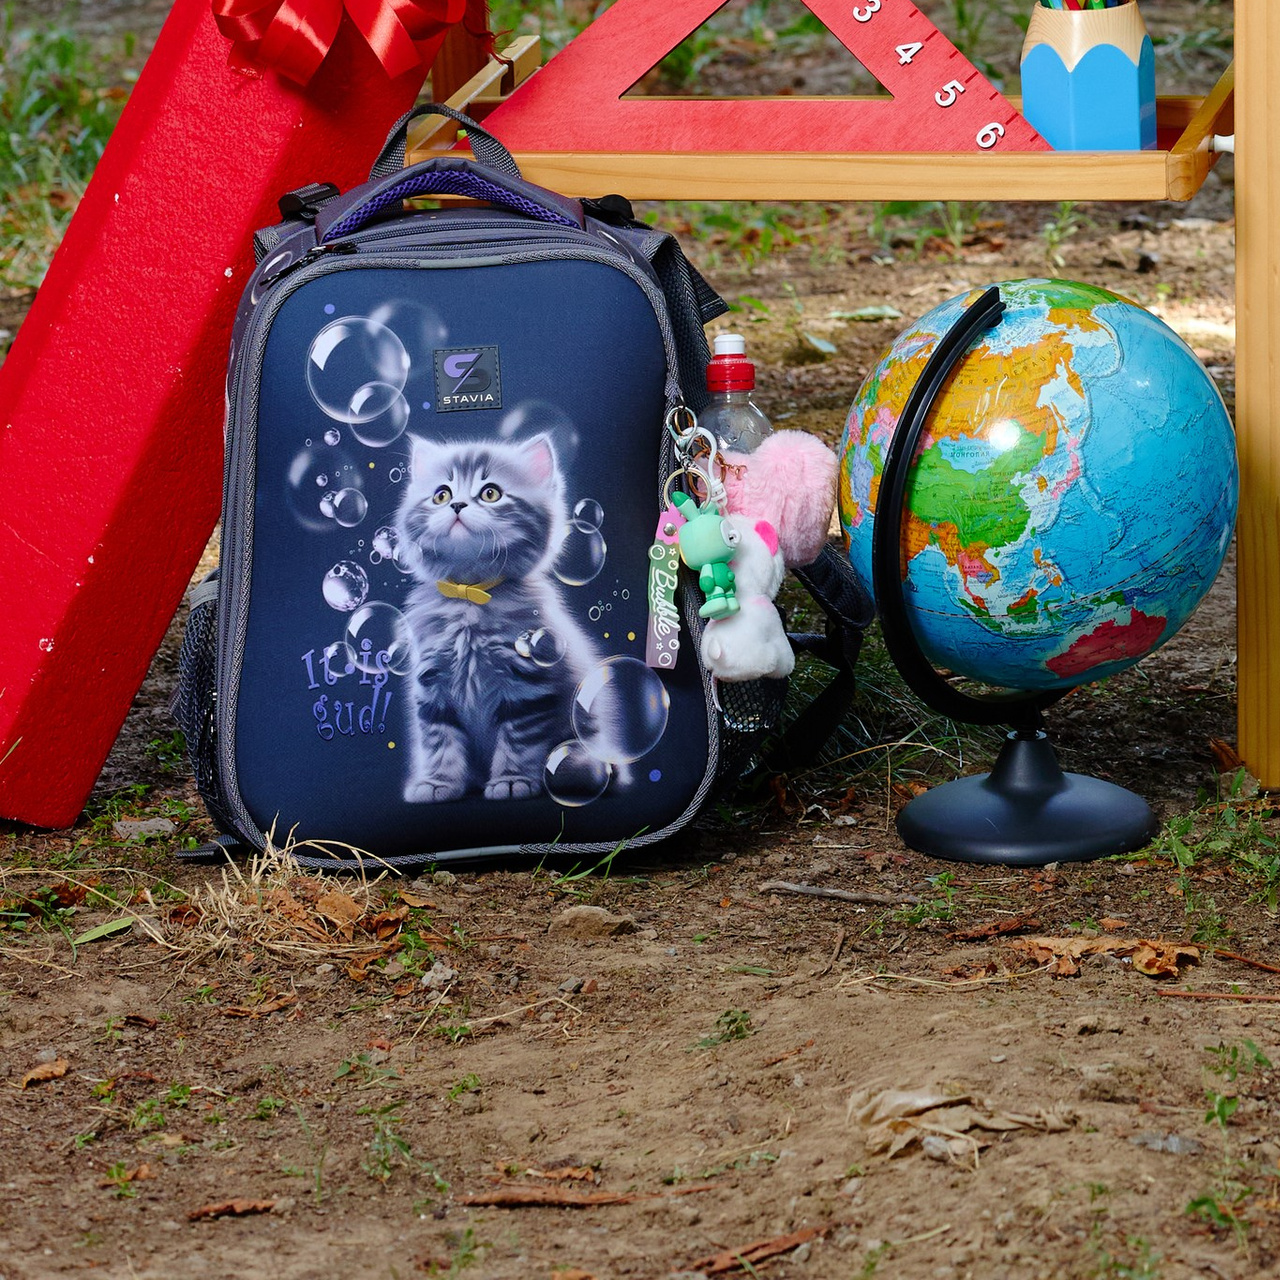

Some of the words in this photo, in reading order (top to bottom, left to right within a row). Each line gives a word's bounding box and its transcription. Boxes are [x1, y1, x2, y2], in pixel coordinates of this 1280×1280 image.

[894, 40, 924, 67] 4
[934, 79, 966, 108] 5
[976, 122, 1005, 149] 6
[443, 393, 494, 405] STAVIA
[653, 568, 681, 638] Bubble
[359, 638, 391, 687] is
[313, 683, 393, 740] gud!
